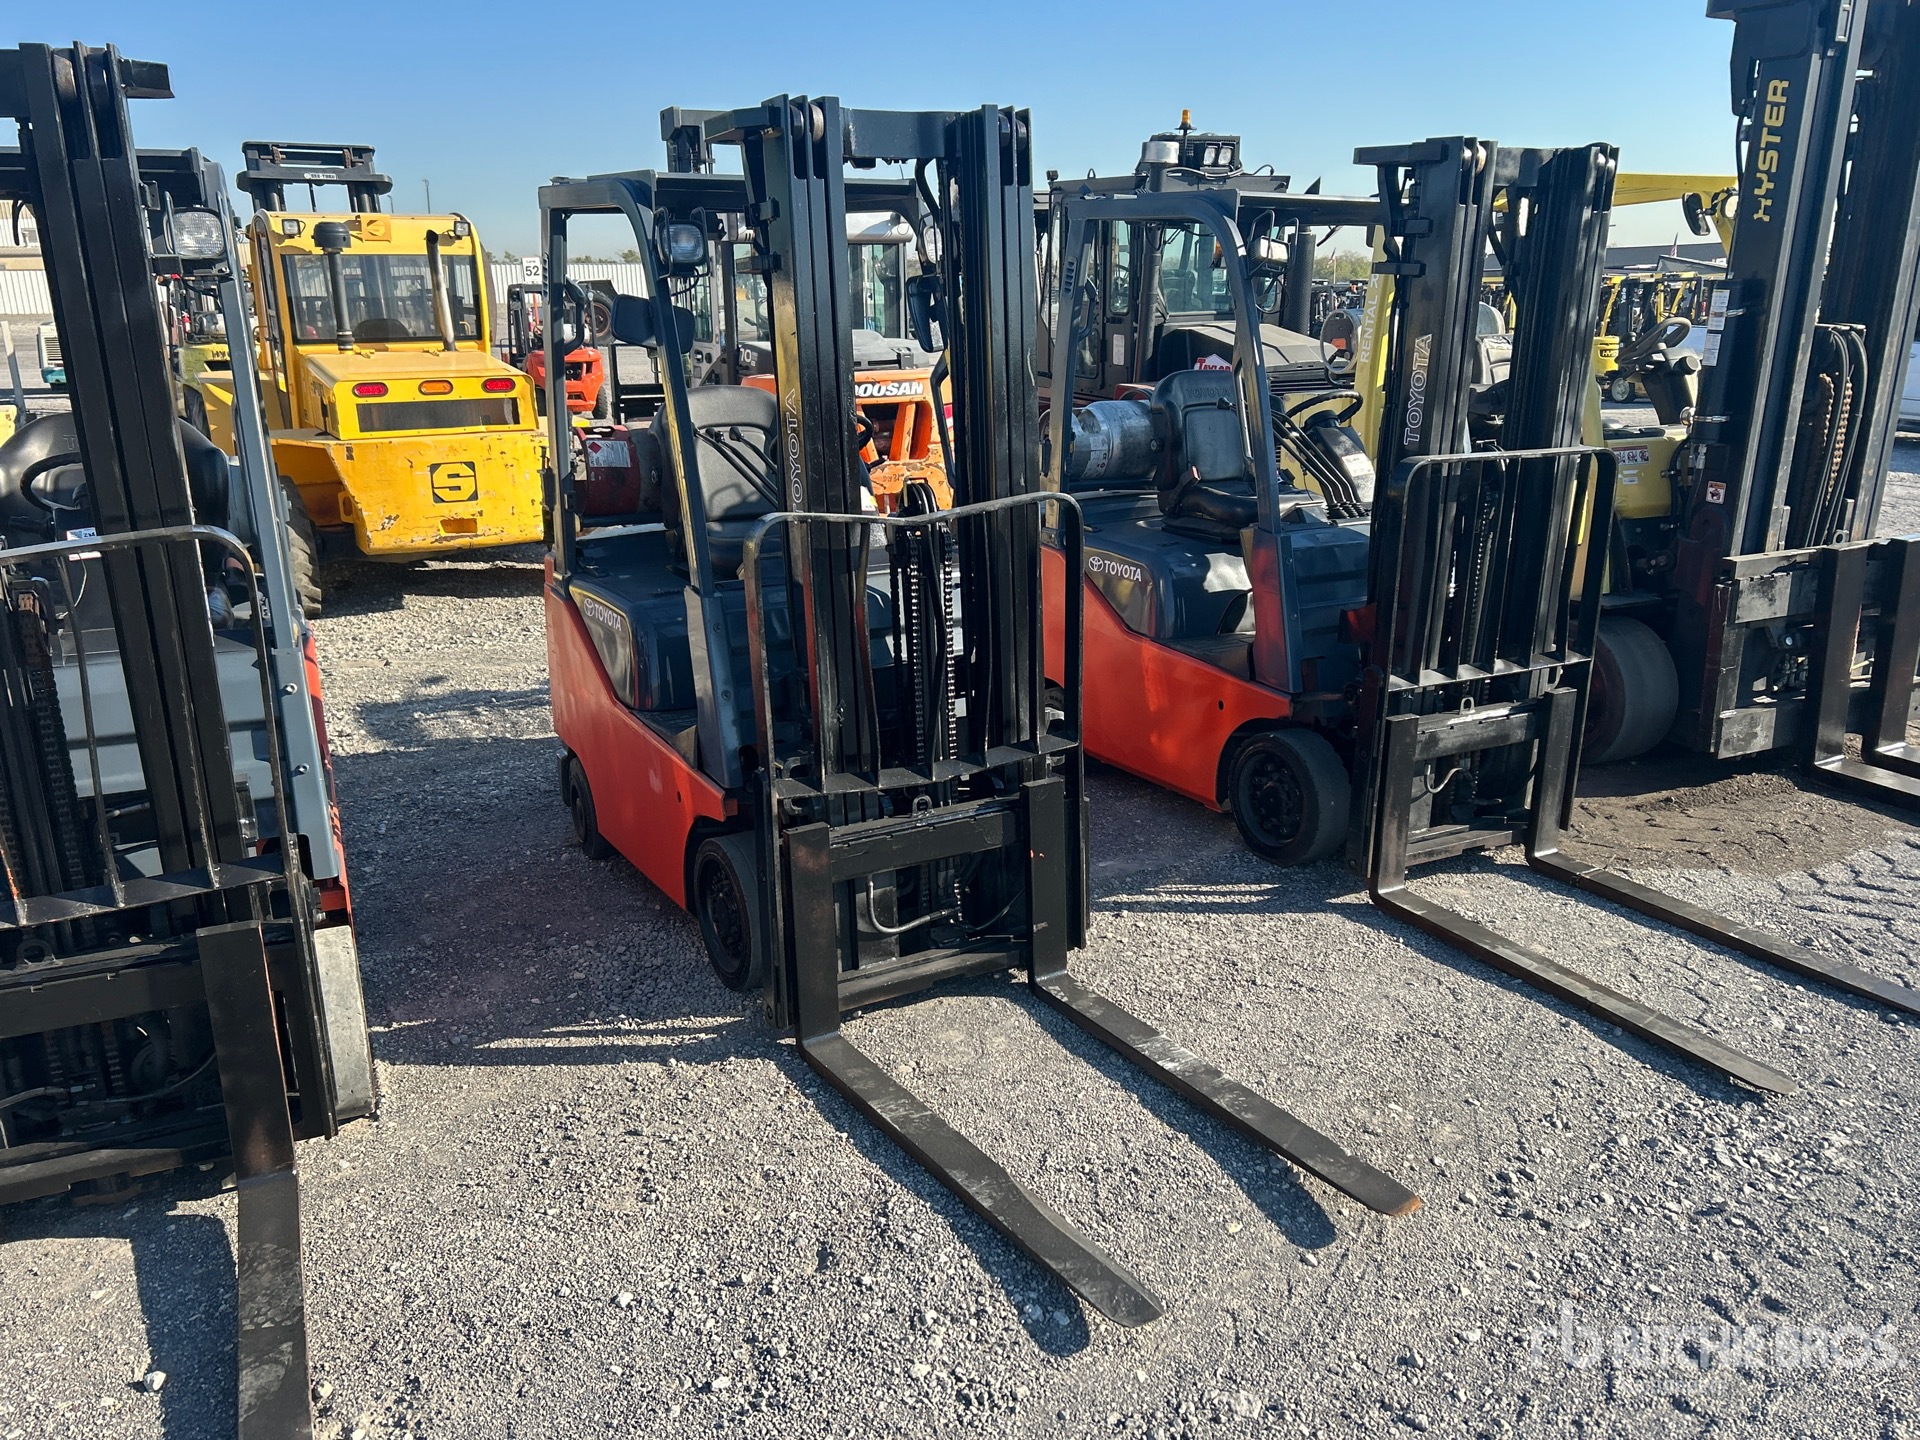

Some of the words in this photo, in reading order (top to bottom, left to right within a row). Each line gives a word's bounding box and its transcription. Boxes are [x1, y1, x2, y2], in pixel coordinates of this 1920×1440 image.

[1753, 79, 1790, 222] HYSTER
[525, 265, 541, 277] 52
[1360, 294, 1379, 363] RENTAL
[1403, 334, 1433, 446] TOYOTA
[1104, 560, 1142, 582] TOYOTA
[594, 603, 622, 632] TOYOTA
